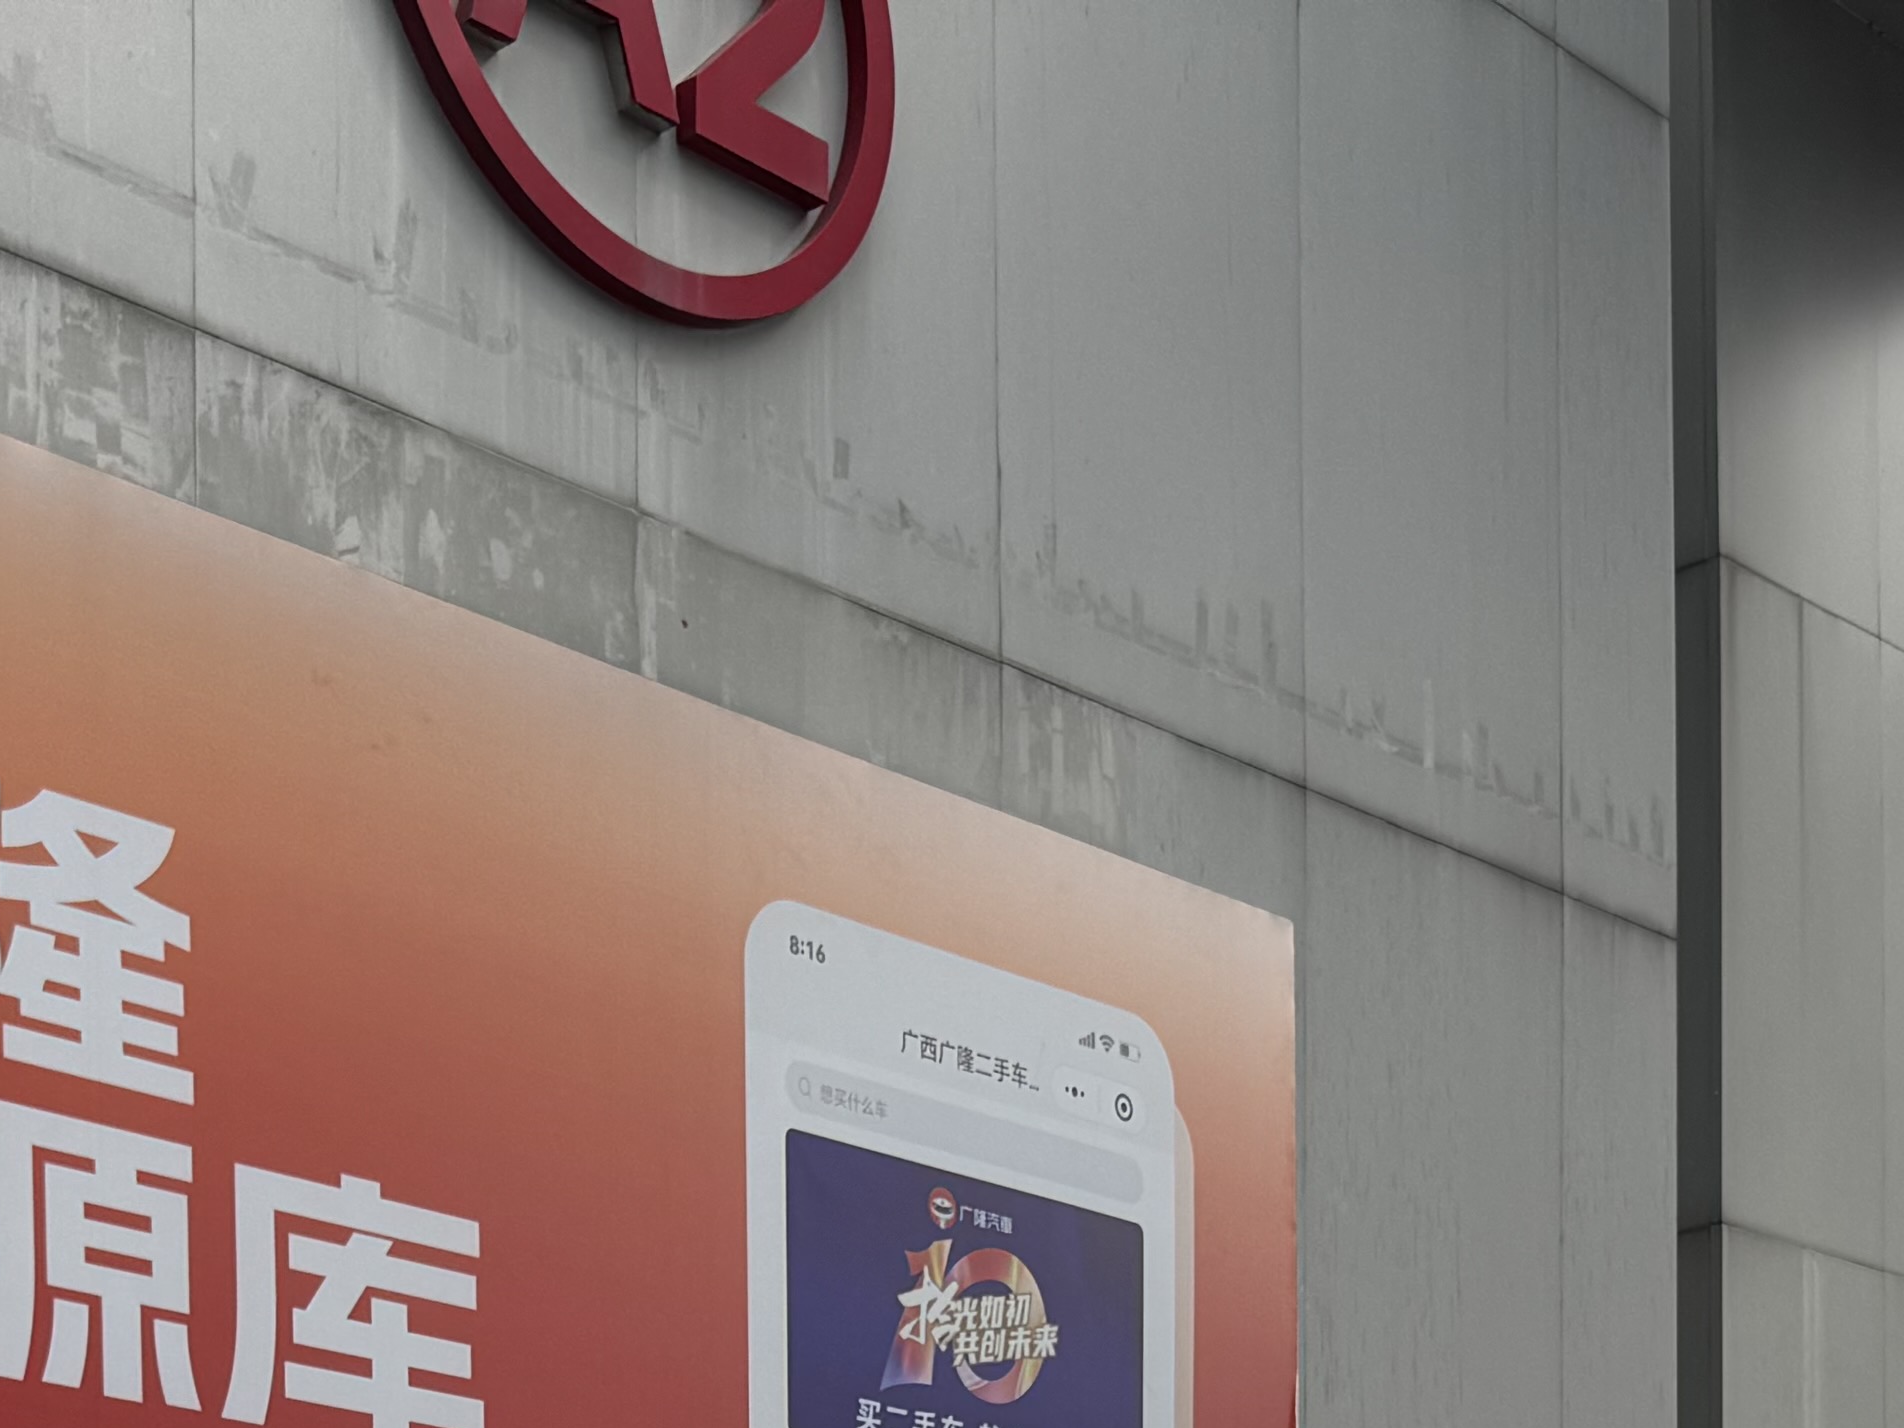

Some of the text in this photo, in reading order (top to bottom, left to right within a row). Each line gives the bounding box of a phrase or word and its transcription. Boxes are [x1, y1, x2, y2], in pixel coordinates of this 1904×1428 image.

[789, 934, 826, 964] 8:16
[819, 1084, 889, 1120] 想买什么车
[959, 1206, 1013, 1235] 广隆汽車
[953, 1322, 1060, 1367] 共创未来
